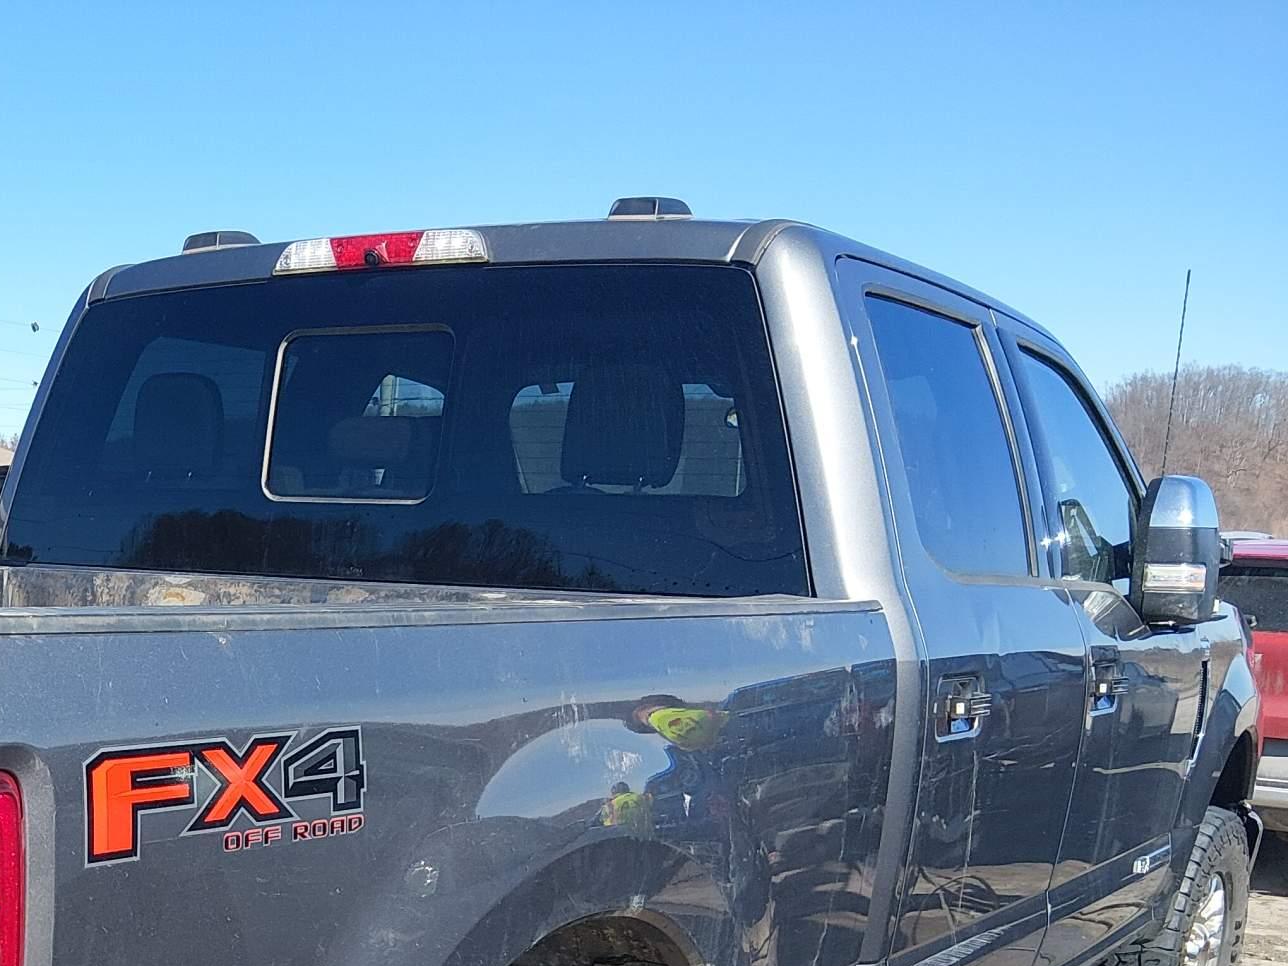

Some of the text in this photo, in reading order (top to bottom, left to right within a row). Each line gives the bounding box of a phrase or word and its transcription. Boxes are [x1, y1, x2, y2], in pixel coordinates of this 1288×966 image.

[83, 724, 367, 868] FX4
[223, 813, 365, 853] OFF ROAD
